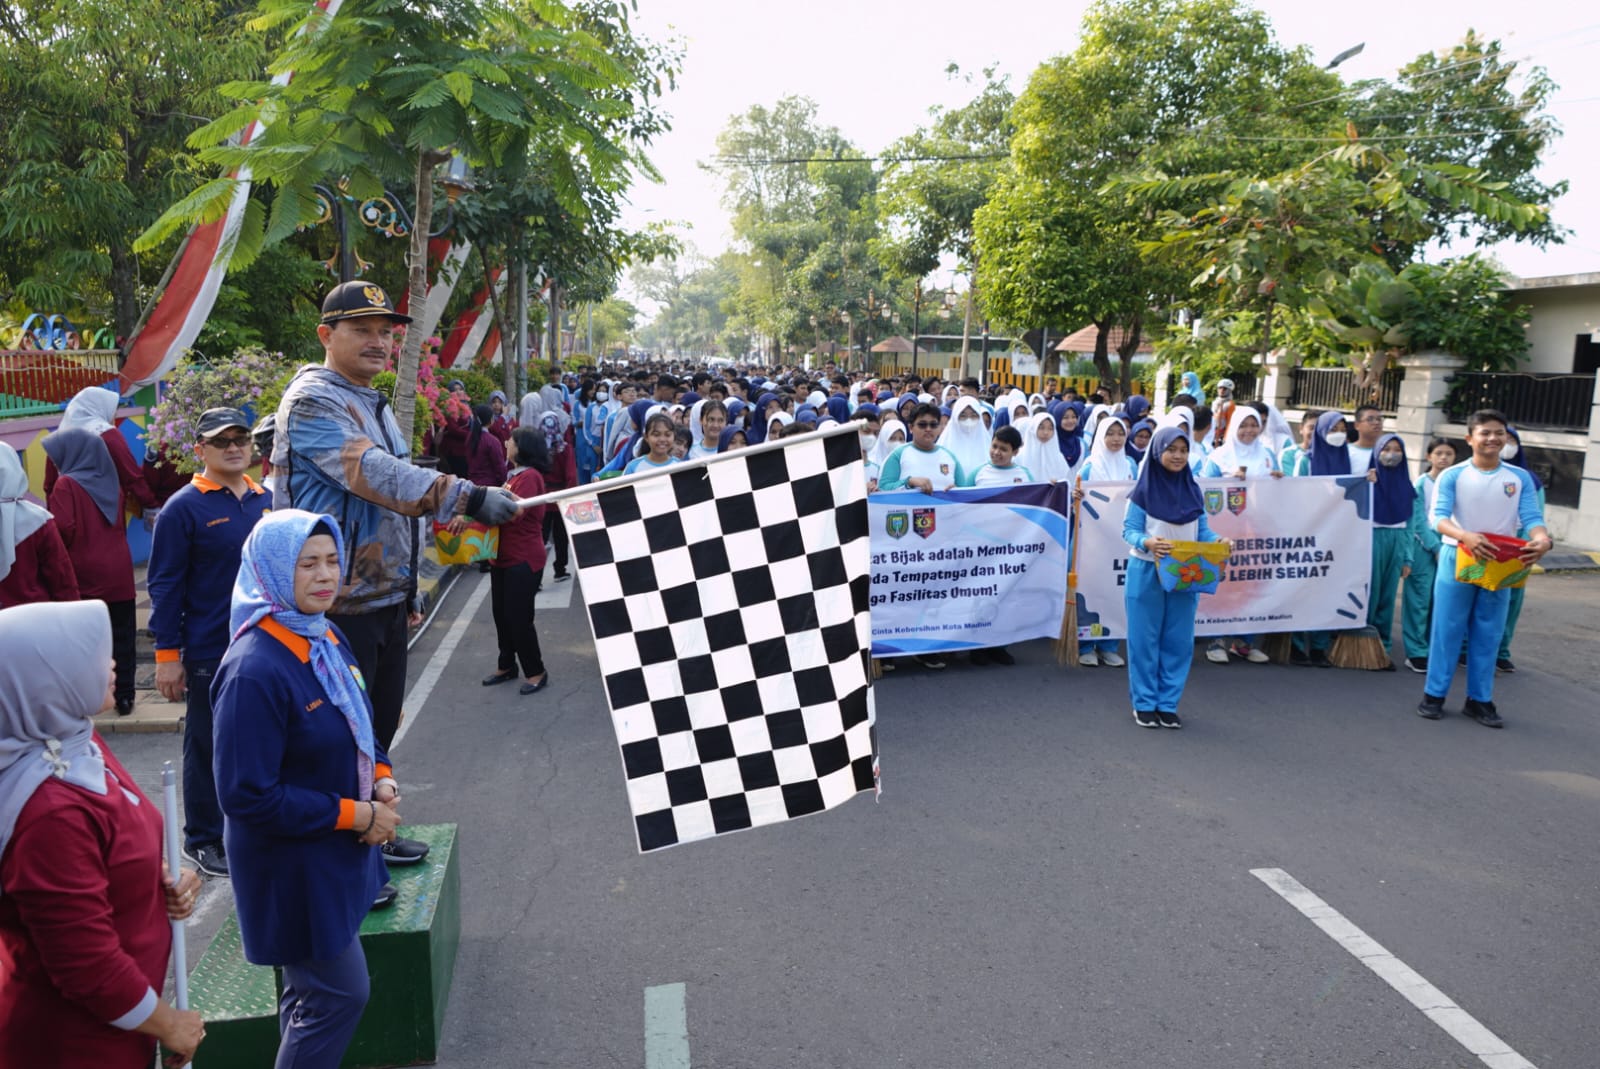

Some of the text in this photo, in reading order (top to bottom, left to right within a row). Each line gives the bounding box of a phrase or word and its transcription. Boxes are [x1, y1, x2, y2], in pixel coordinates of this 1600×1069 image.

[871, 542, 1045, 565] at Bijak adalah Membuang
[1229, 553, 1282, 567] UNTUK
[1285, 550, 1334, 563] MASA
[870, 563, 1026, 585] da Tempatnya dan Ikut
[1229, 568, 1272, 582] LEBIH
[1275, 565, 1330, 579] SEHAT
[890, 588, 948, 604] Fasilitas
[950, 584, 998, 599] Umum!
[871, 627, 893, 636] Cinta
[942, 623, 962, 631] Kota
